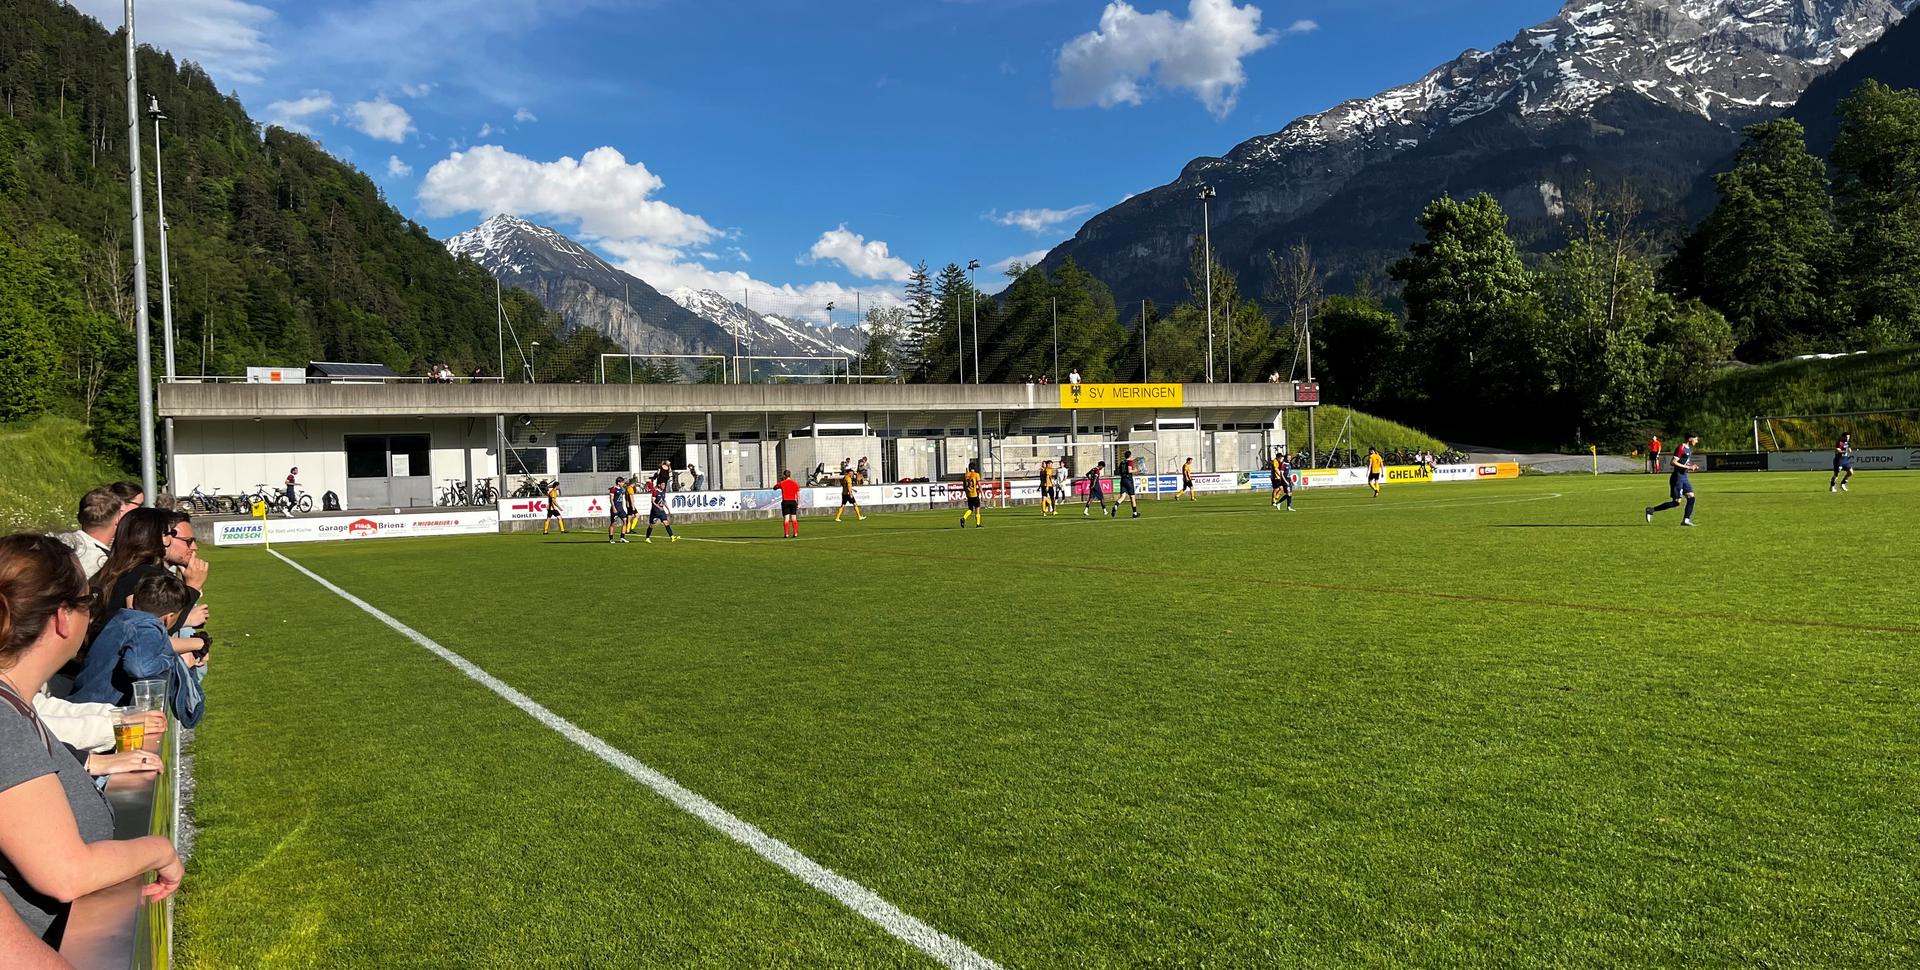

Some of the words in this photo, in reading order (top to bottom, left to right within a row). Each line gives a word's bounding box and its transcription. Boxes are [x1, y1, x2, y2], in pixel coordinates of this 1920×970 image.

[1089, 387, 1105, 398] SV
[1113, 387, 1175, 398] MEIRINGEN
[1856, 455, 1893, 464] FLOTRON
[893, 485, 946, 499] GISLER
[223, 525, 263, 533] SANITAS
[318, 525, 348, 533] Garage
[379, 522, 404, 530] Brienz
[222, 532, 261, 540] TROESCH
